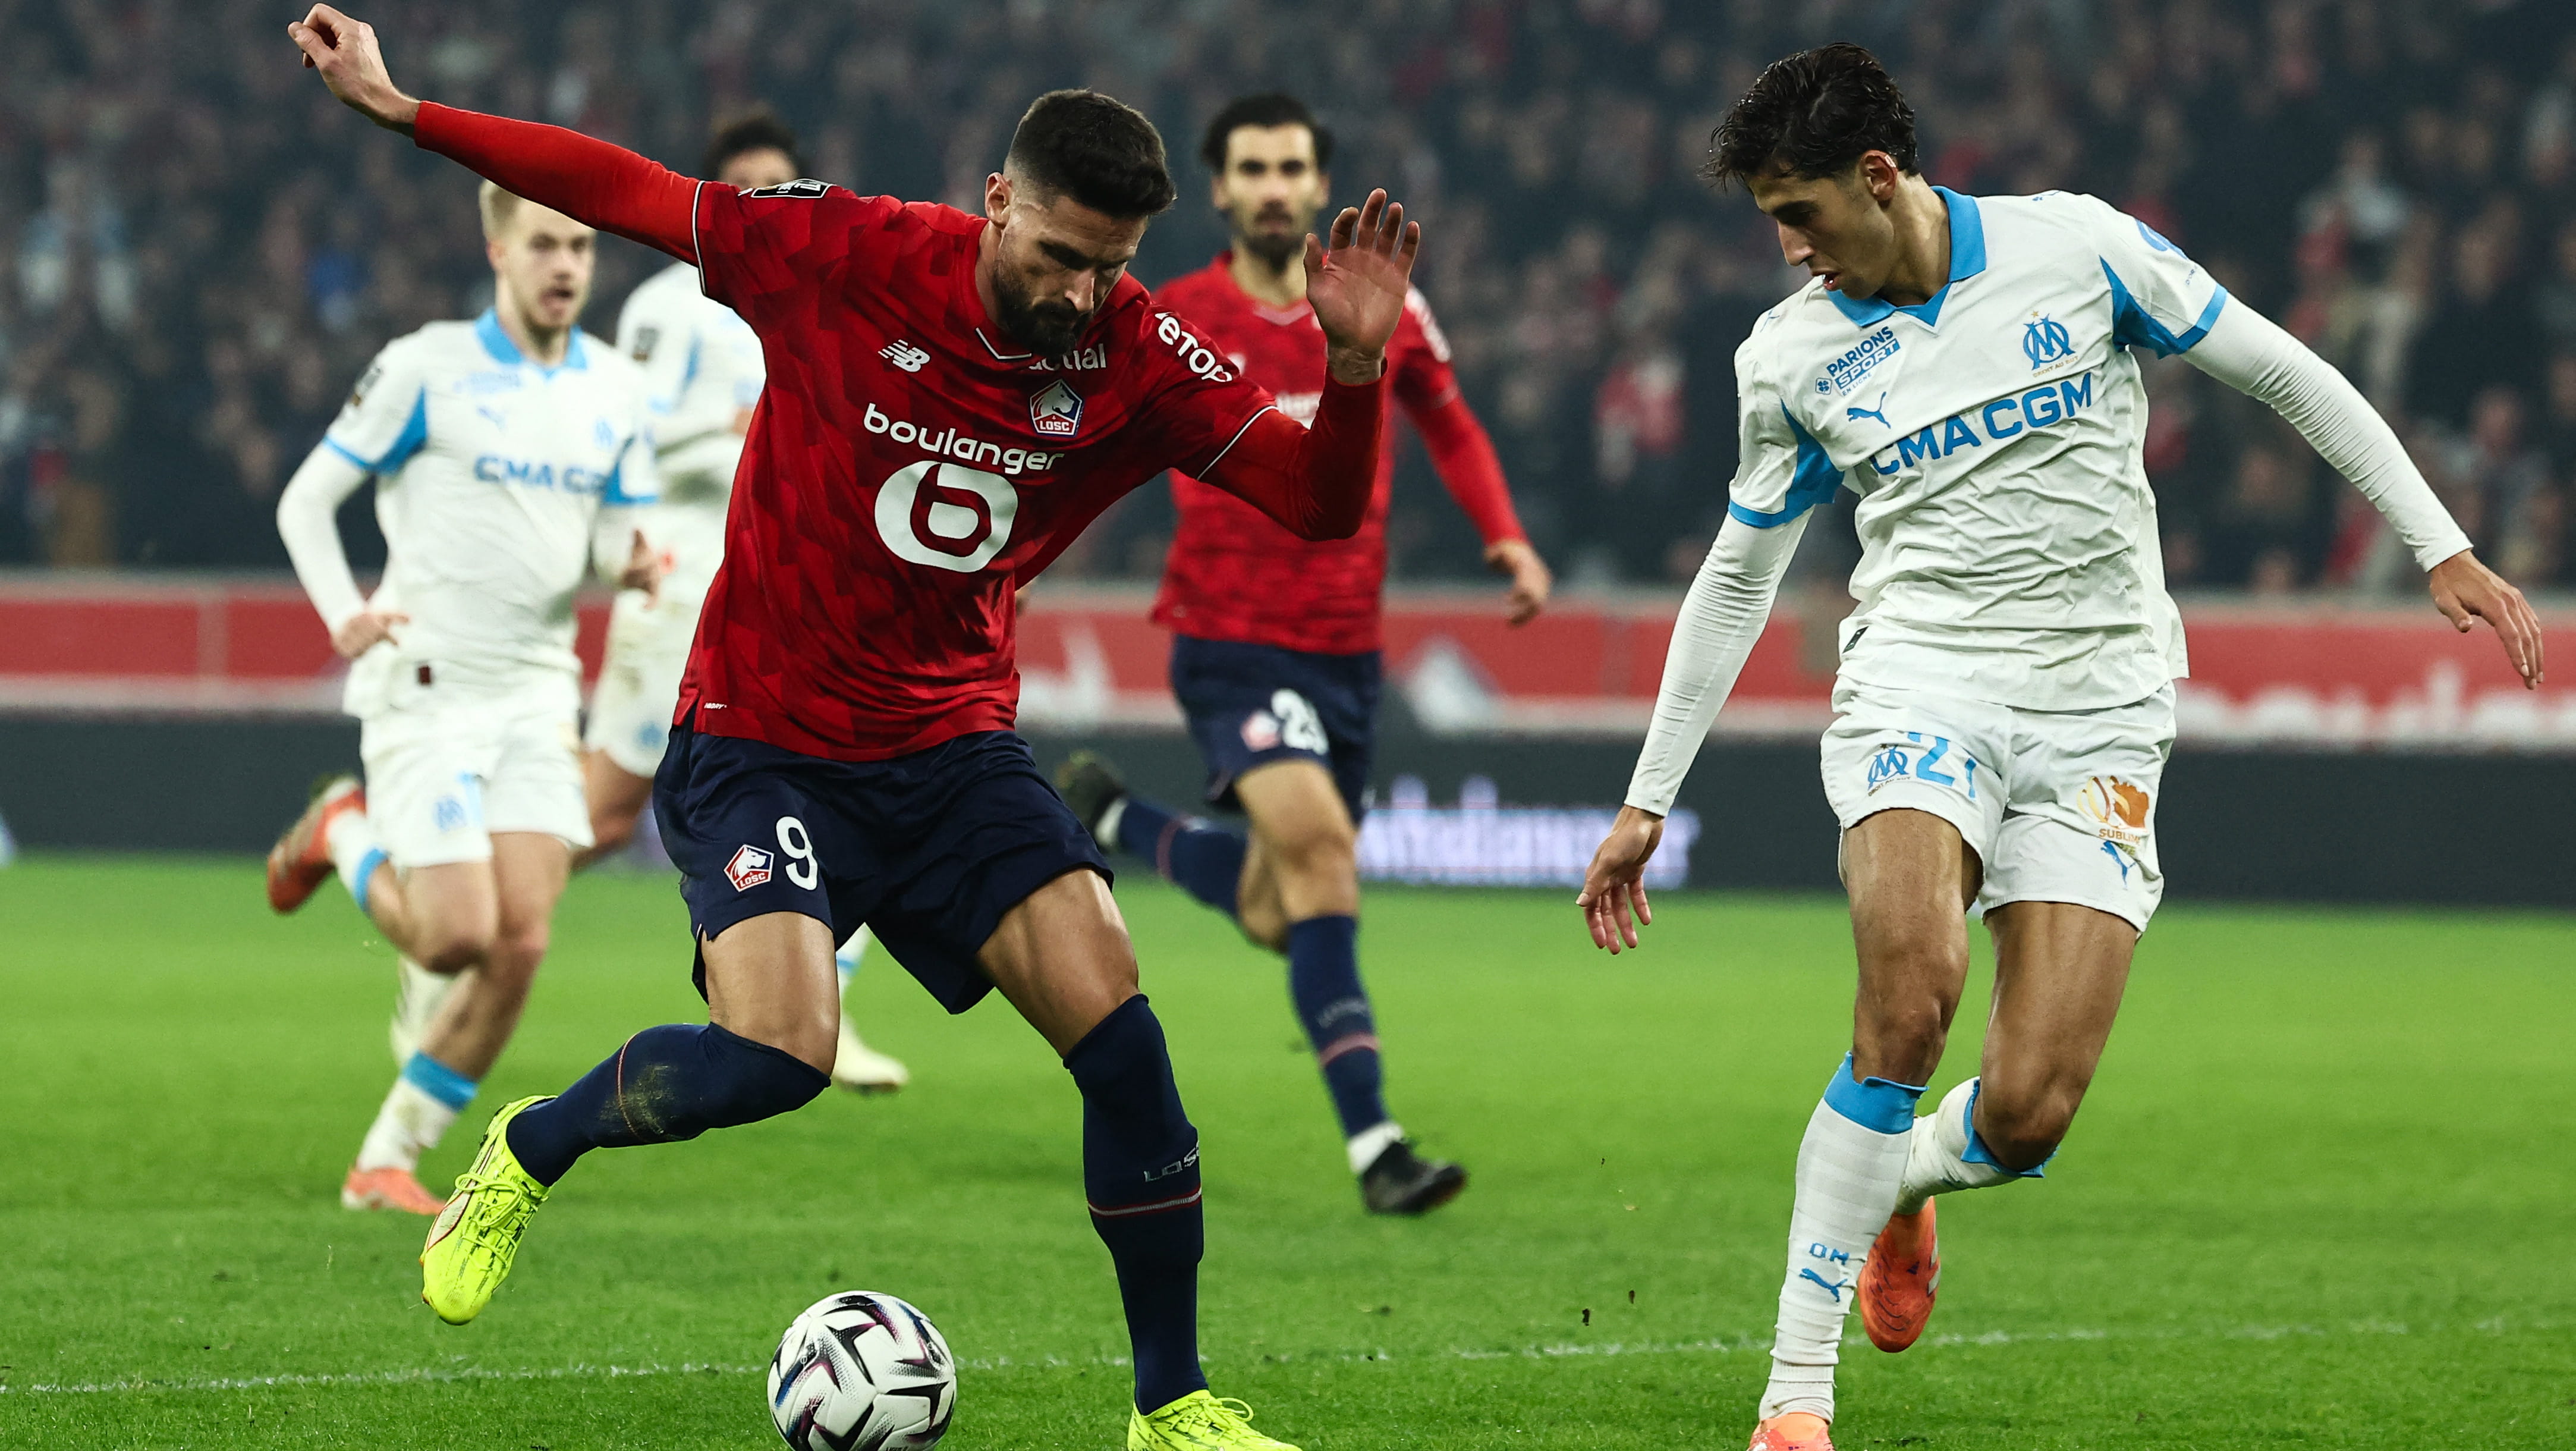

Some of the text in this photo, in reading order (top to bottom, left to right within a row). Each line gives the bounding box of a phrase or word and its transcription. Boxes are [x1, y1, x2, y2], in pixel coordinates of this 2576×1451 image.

[1826, 326, 1894, 377] PARIONS
[1838, 340, 1898, 388] SPORT
[1852, 372, 1872, 388] LIGNE
[863, 403, 1065, 475] boulanger
[1040, 420, 1070, 432] LOSC
[1869, 373, 2091, 475] CMA CGM
[474, 456, 555, 489] CMA
[776, 816, 818, 890] 9
[739, 872, 766, 889] LOSC
[1810, 1243, 1850, 1265] OM
